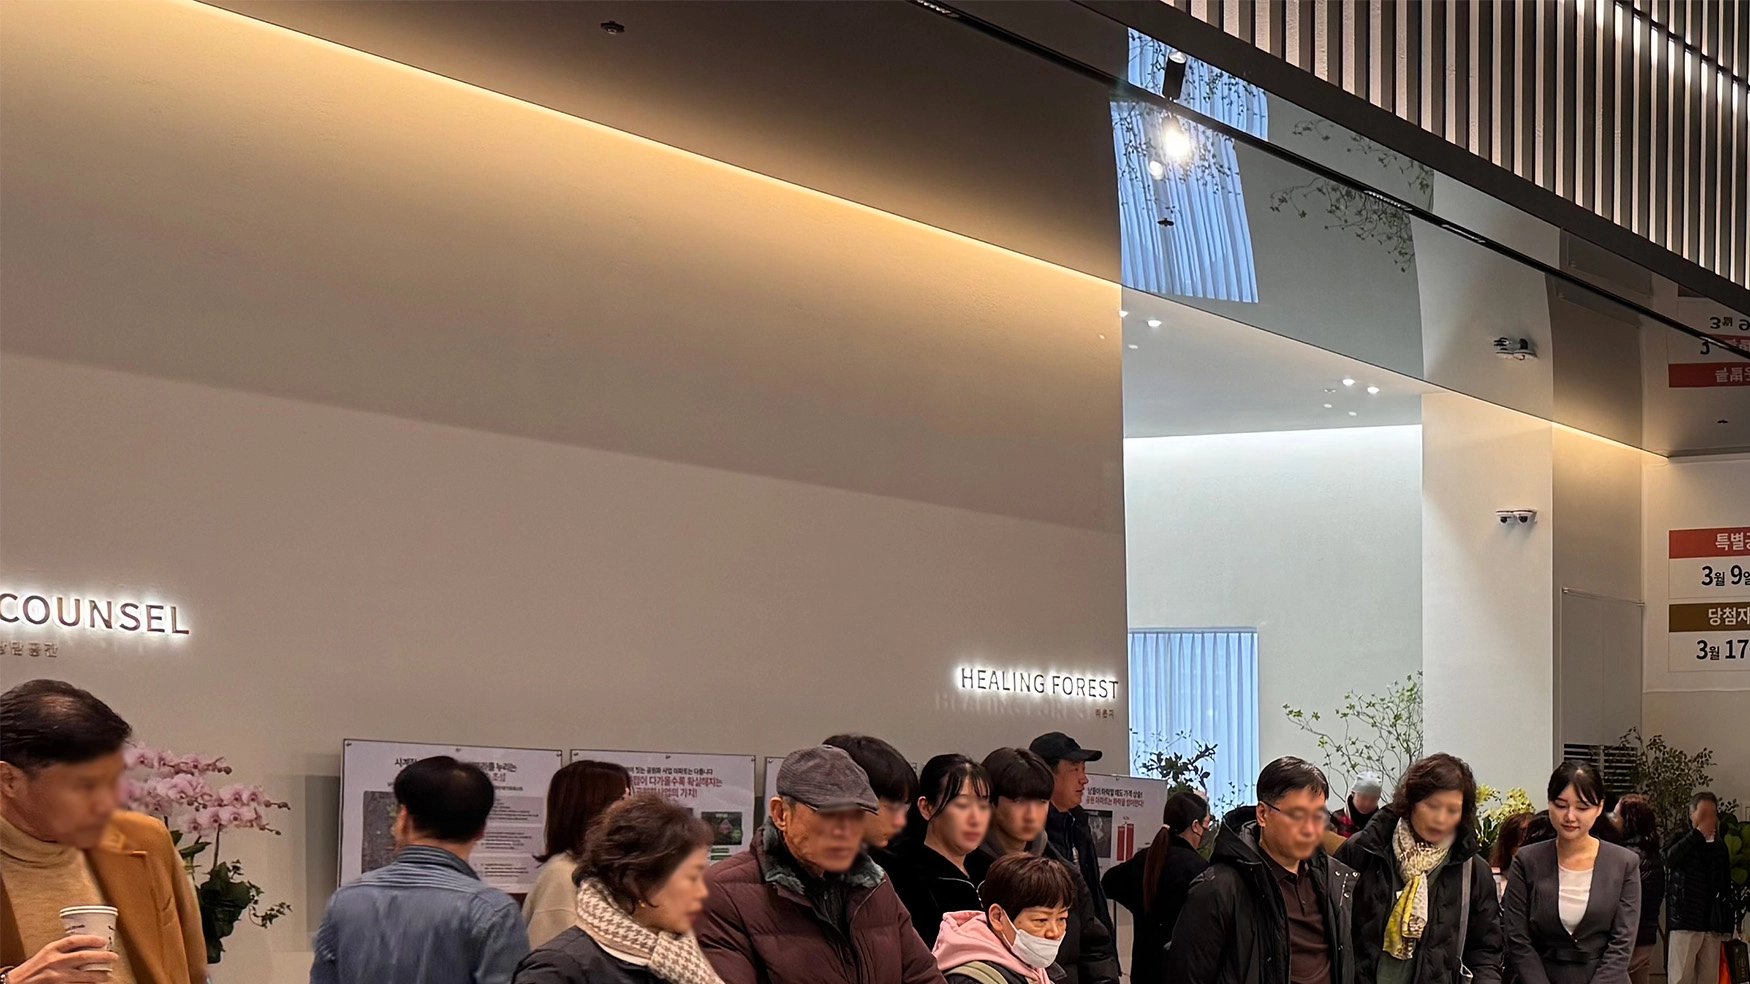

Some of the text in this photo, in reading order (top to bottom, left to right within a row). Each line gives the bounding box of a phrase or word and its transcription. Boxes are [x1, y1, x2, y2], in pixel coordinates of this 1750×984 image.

[1701, 565, 1726, 587] 3월
[0, 592, 190, 636] COUNSEL
[1696, 639, 1720, 660] 3월
[961, 668, 1119, 699] HEALING FOREST
